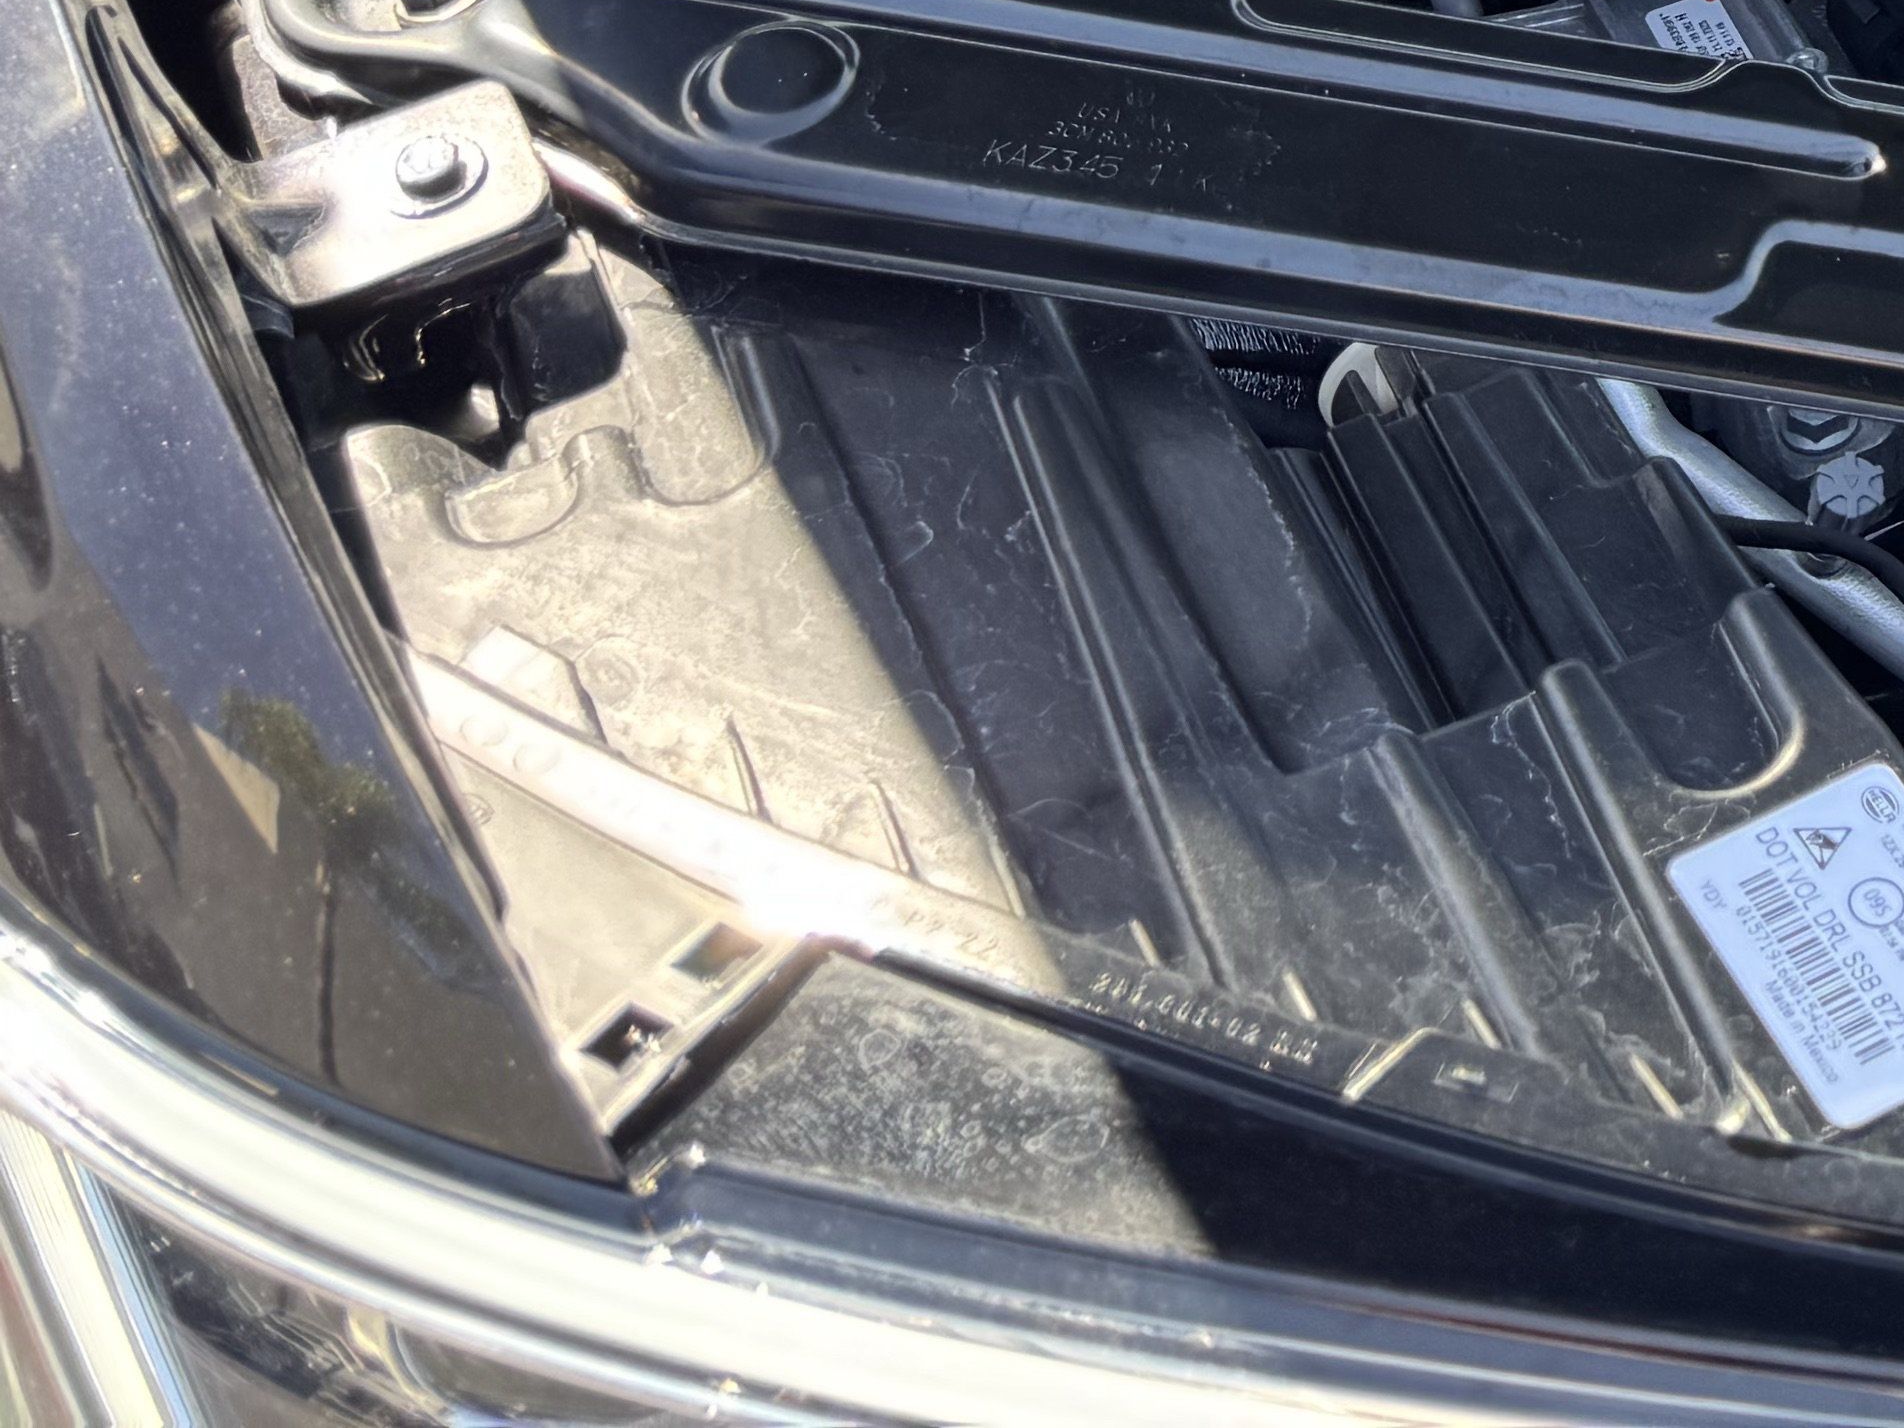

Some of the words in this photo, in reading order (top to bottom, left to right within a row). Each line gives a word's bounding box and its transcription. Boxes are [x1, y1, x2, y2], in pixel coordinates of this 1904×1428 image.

[1753, 825, 1799, 870] DOT
[1781, 866, 1827, 911] VOL
[1810, 907, 1856, 953] DRL
[1839, 948, 1885, 994] SSB
[1760, 977, 1800, 1020] Made
[1788, 1016, 1810, 1035] in
[1797, 1031, 1845, 1085] Mexico
